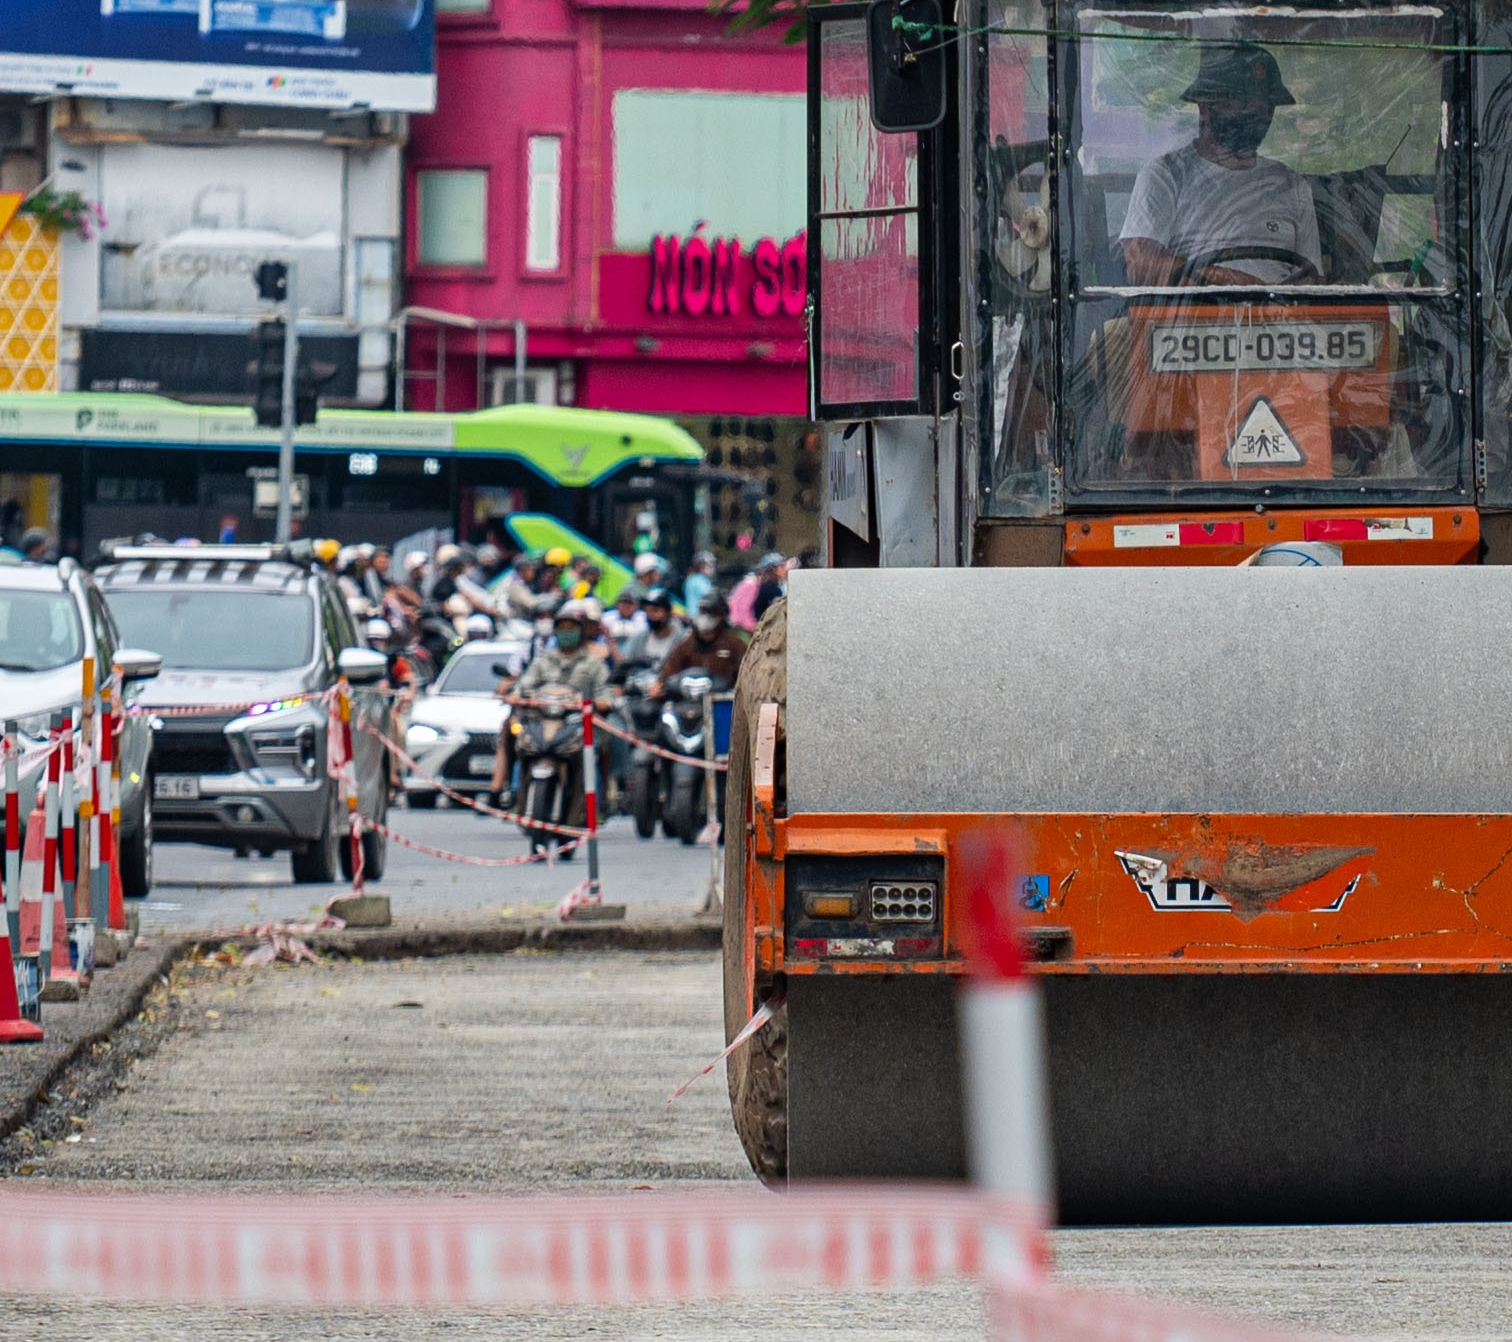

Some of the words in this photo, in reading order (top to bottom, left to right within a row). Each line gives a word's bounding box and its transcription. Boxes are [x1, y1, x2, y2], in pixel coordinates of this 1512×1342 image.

[651, 219, 742, 314] NÓN
[752, 228, 808, 316] SƠ
[1161, 331, 1366, 364] 29CD-039.85
